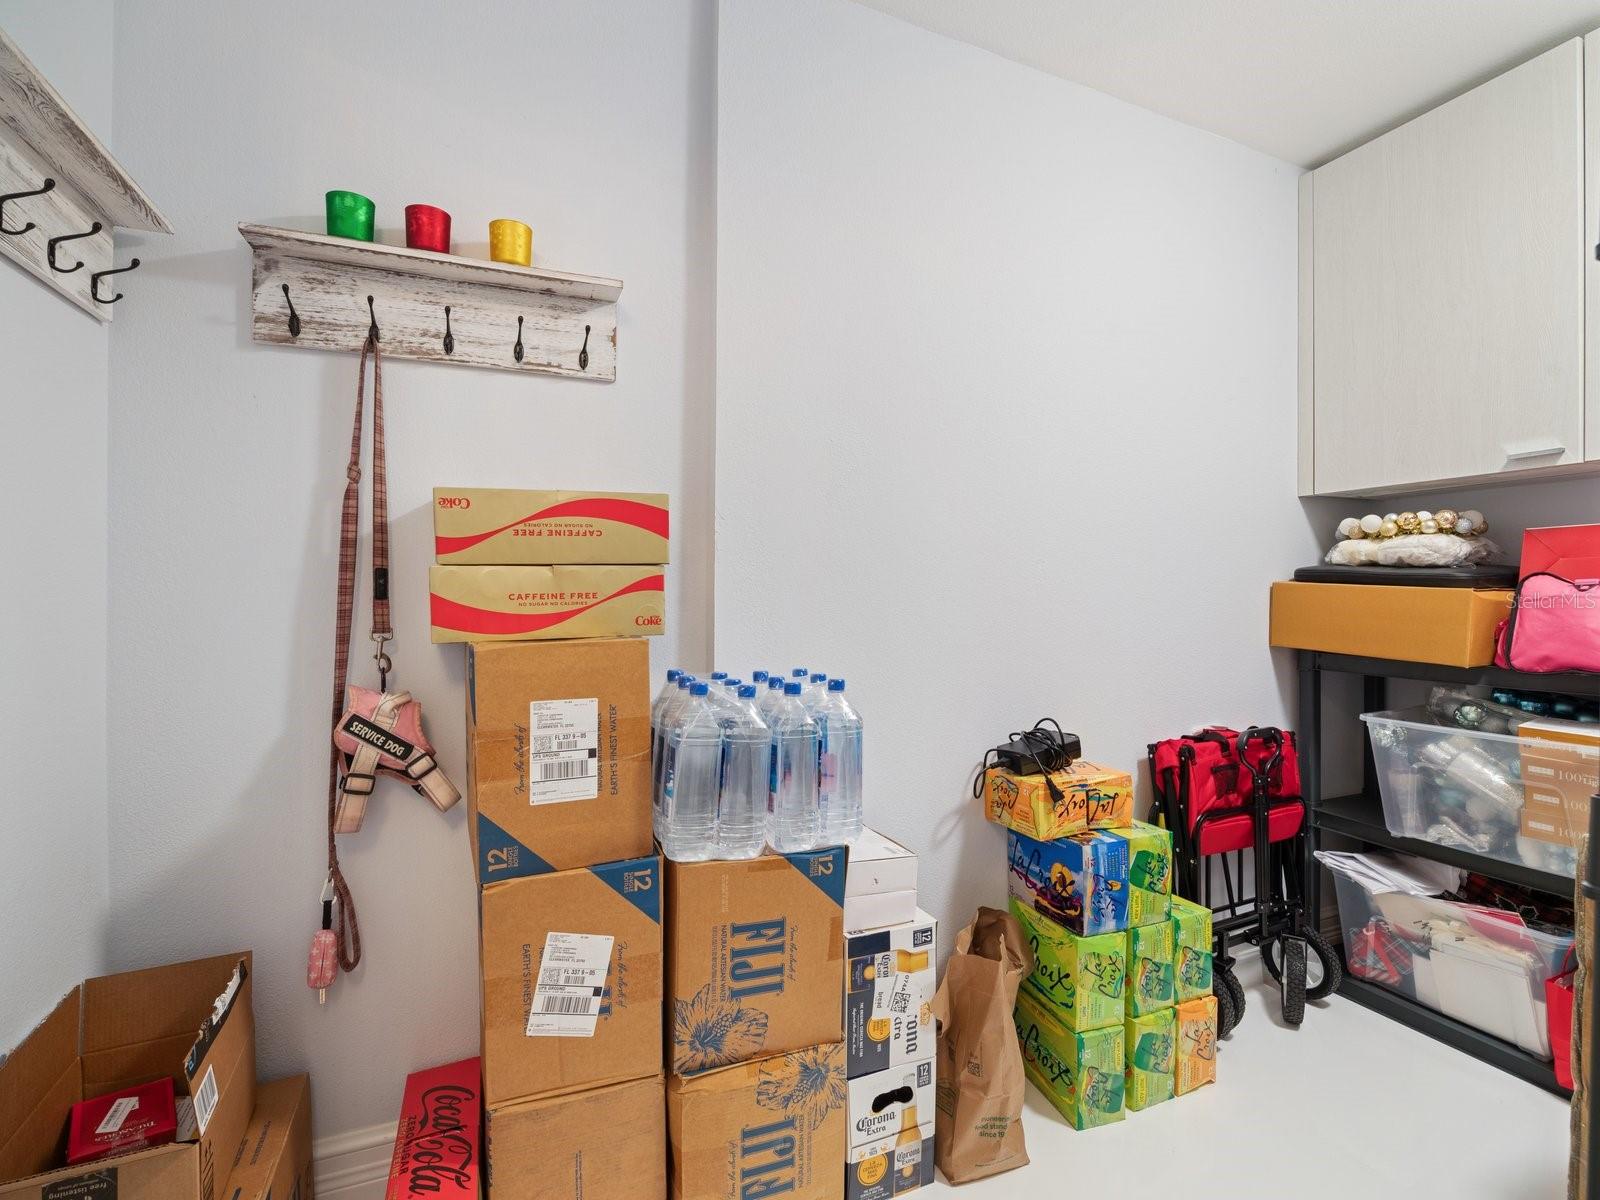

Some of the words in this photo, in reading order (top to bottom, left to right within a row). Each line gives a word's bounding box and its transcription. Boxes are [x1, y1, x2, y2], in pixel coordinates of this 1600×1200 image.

[438, 497, 471, 510] Coke
[512, 529, 543, 537] FREE
[548, 529, 603, 537] CAFFEINE
[508, 592, 566, 601] CAFFEINE
[569, 592, 600, 600] FREE
[635, 615, 662, 626] Coke
[349, 721, 386, 746] SERVICE
[384, 740, 405, 756] DOG
[609, 735, 617, 761] FINEST
[610, 763, 618, 795] EARTH'S
[487, 847, 508, 872] 12
[818, 854, 834, 876] 12
[633, 868, 652, 892] 12
[922, 930, 932, 942] 12
[522, 943, 531, 977] EARTH'S
[729, 916, 787, 1000] FIJI
[522, 979, 531, 1006] FINEST
[876, 991, 884, 1009] bread
[919, 1064, 929, 1076] 12
[856, 1111, 896, 1132] Corona
[864, 1125, 886, 1137] Extra
[740, 1115, 796, 1200] FIJI
[896, 1147, 921, 1162] Corona
[48, 1187, 88, 1200] listening
[89, 1181, 107, 1190] free
